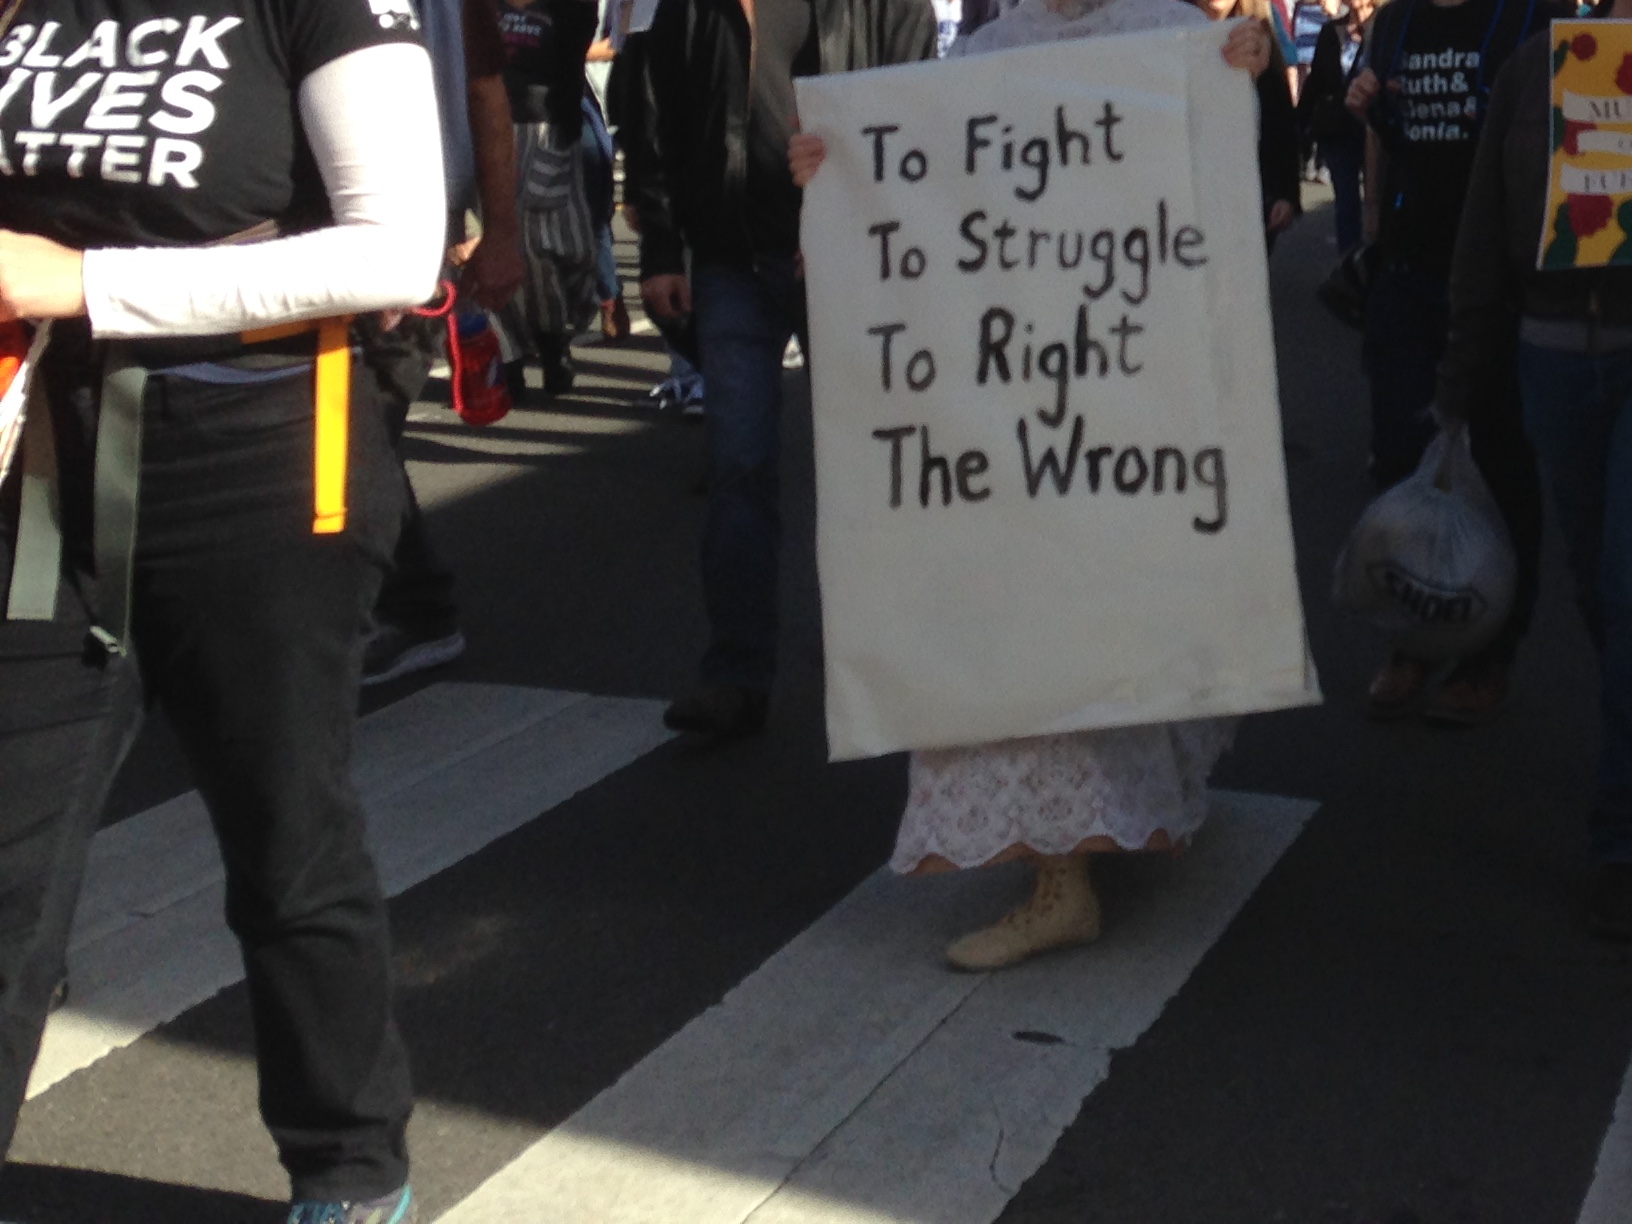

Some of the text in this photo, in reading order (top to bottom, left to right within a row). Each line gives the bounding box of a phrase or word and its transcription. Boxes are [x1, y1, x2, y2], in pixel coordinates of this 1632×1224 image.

[1402, 47, 1480, 69] andra
[0, 68, 224, 135] IVES
[1405, 122, 1468, 141] onia.
[0, 130, 204, 189] TTER
[862, 102, 1124, 202] To Fight
[868, 199, 1209, 304] To Struggle
[867, 304, 1145, 429] To Right
[872, 415, 1228, 534] The Wrong
